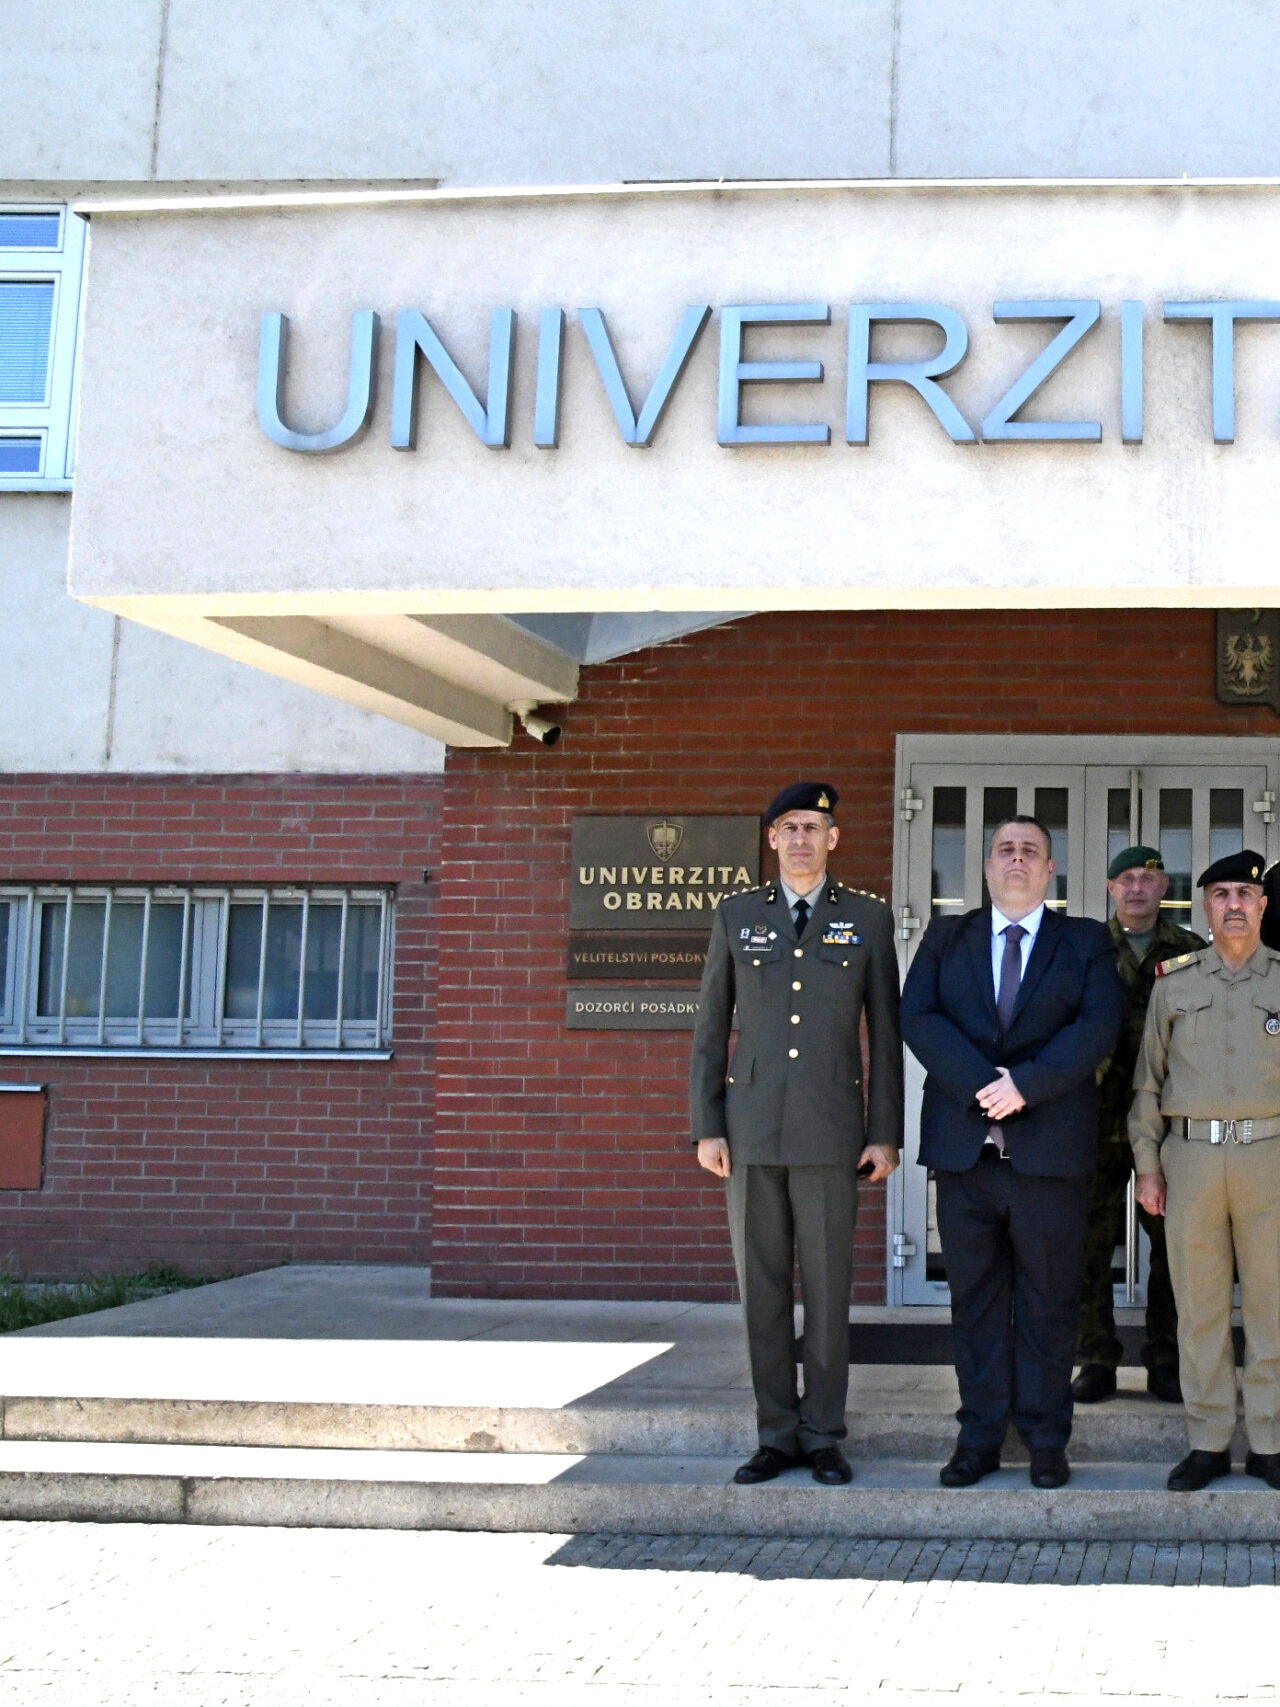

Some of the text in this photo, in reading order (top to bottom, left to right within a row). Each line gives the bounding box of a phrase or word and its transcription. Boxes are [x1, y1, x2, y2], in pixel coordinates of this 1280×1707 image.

[579, 866, 752, 885] UNIVERZITA
[603, 892, 723, 910] OBRANY
[575, 1001, 635, 1013] DOZORČÍ
